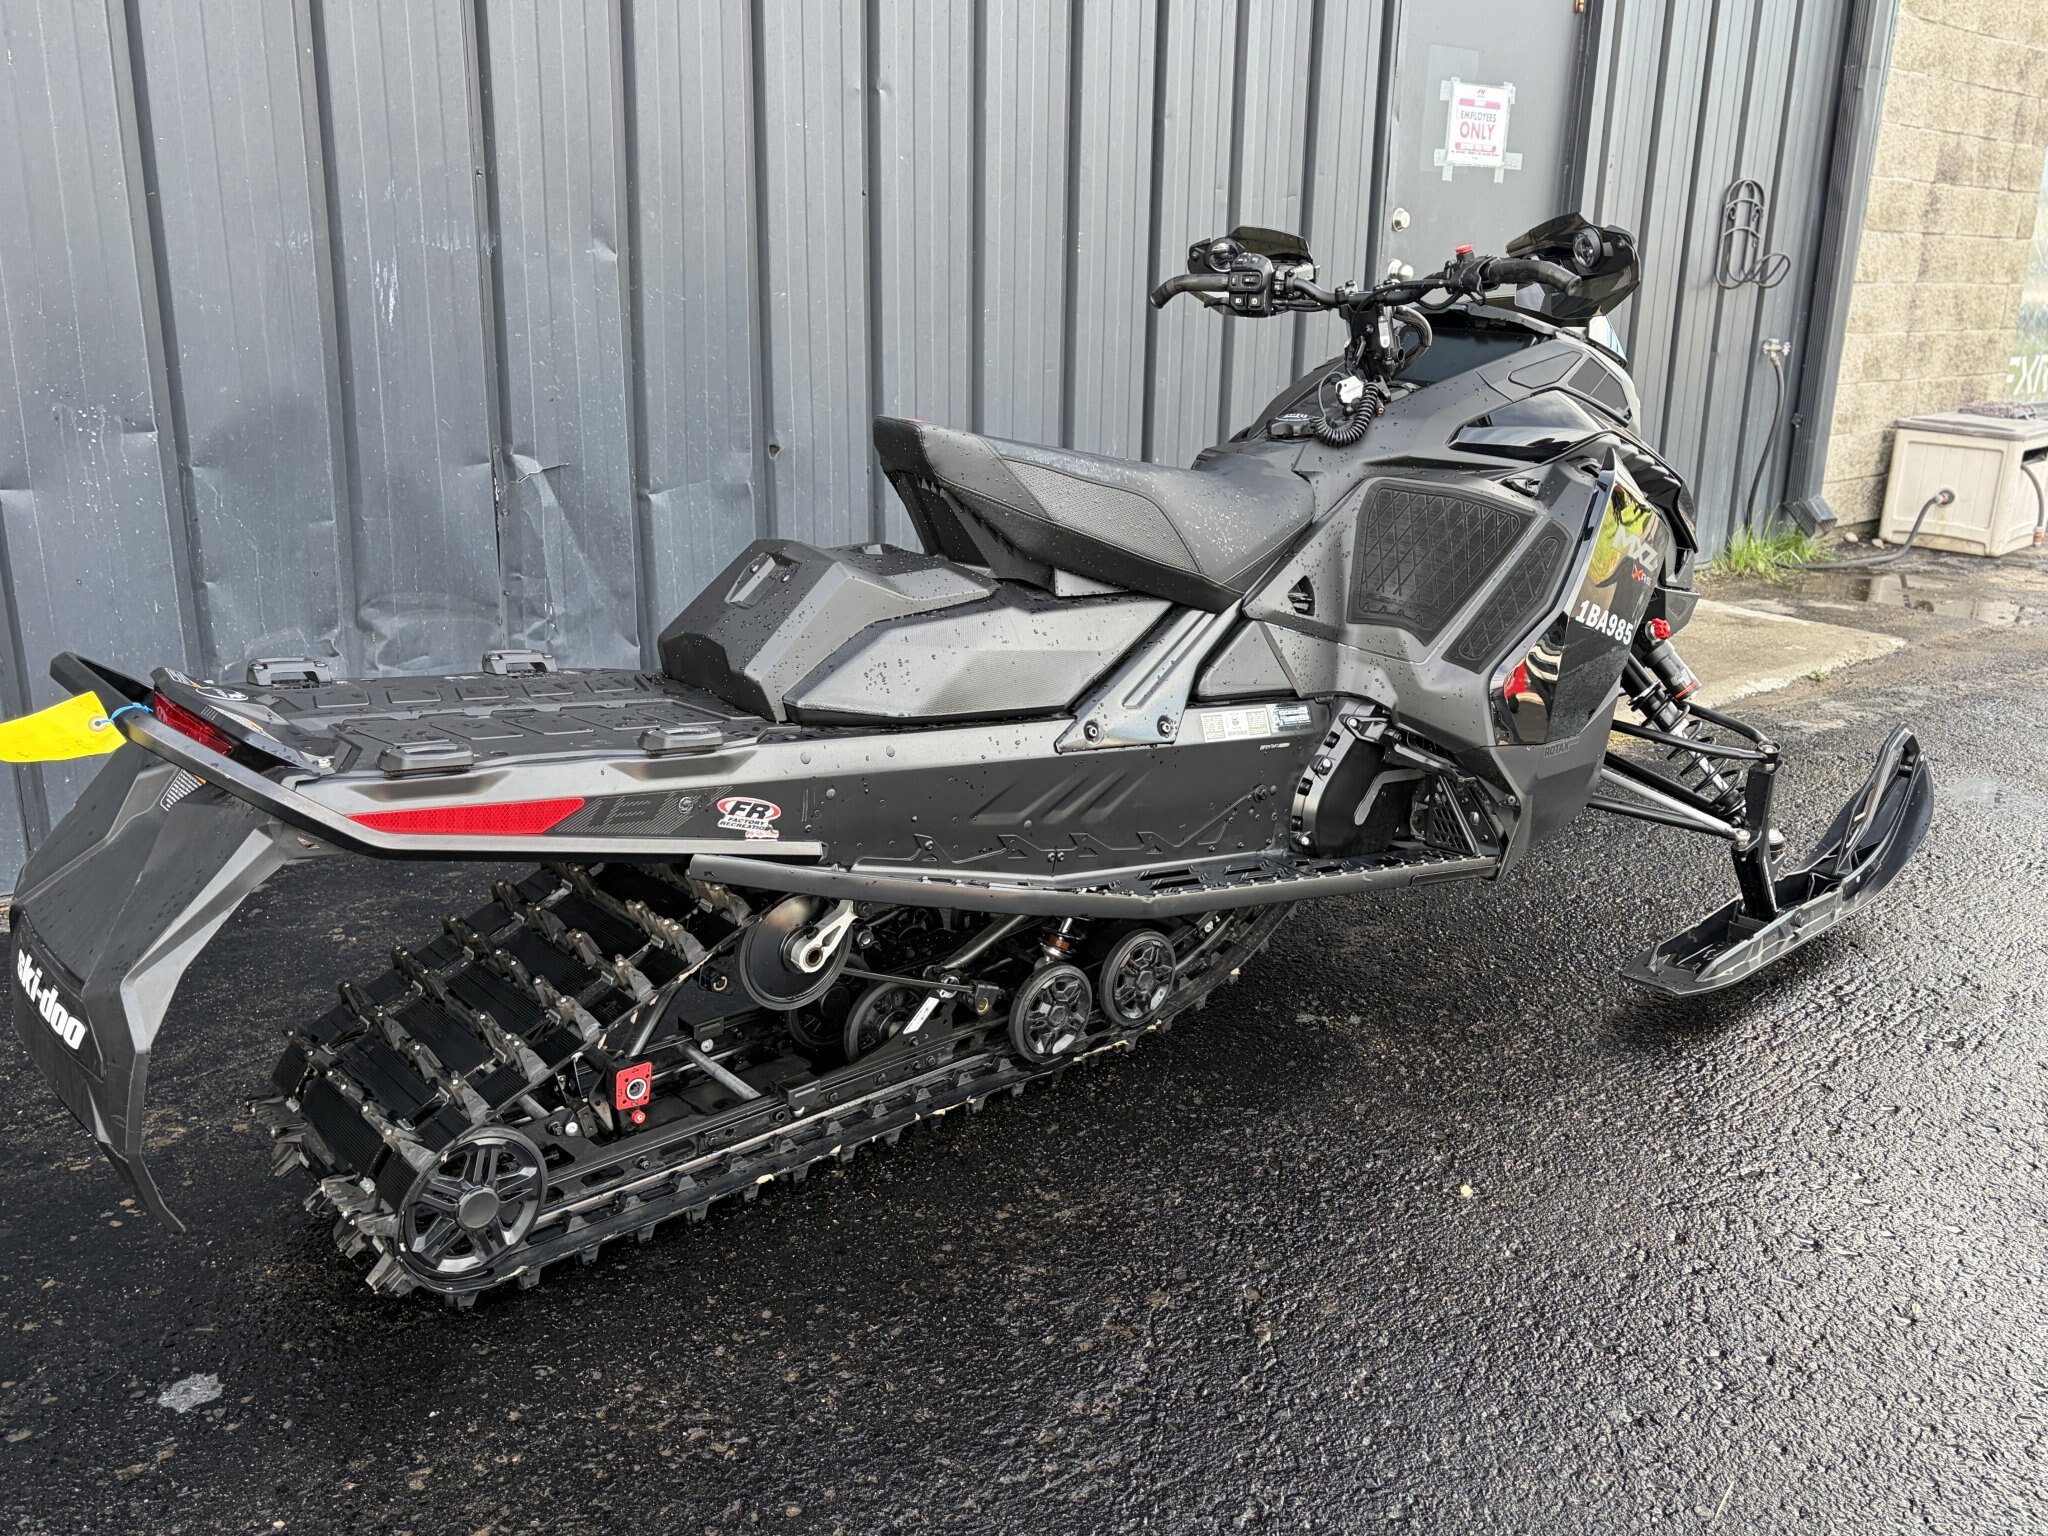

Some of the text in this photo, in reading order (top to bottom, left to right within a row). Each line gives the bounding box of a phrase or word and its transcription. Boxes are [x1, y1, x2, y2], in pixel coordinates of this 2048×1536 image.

[1460, 110, 1497, 123] EMPLOYEES
[1459, 121, 1495, 140] ONLY
[1612, 523, 1658, 572] MXZ
[1575, 600, 1634, 645] 1BA985
[1544, 741, 1570, 757] ROTAX
[727, 800, 772, 820] FR
[719, 821, 773, 832] RECREATION
[727, 817, 767, 826] FACTORY
[17, 948, 86, 1050] ski-doo
